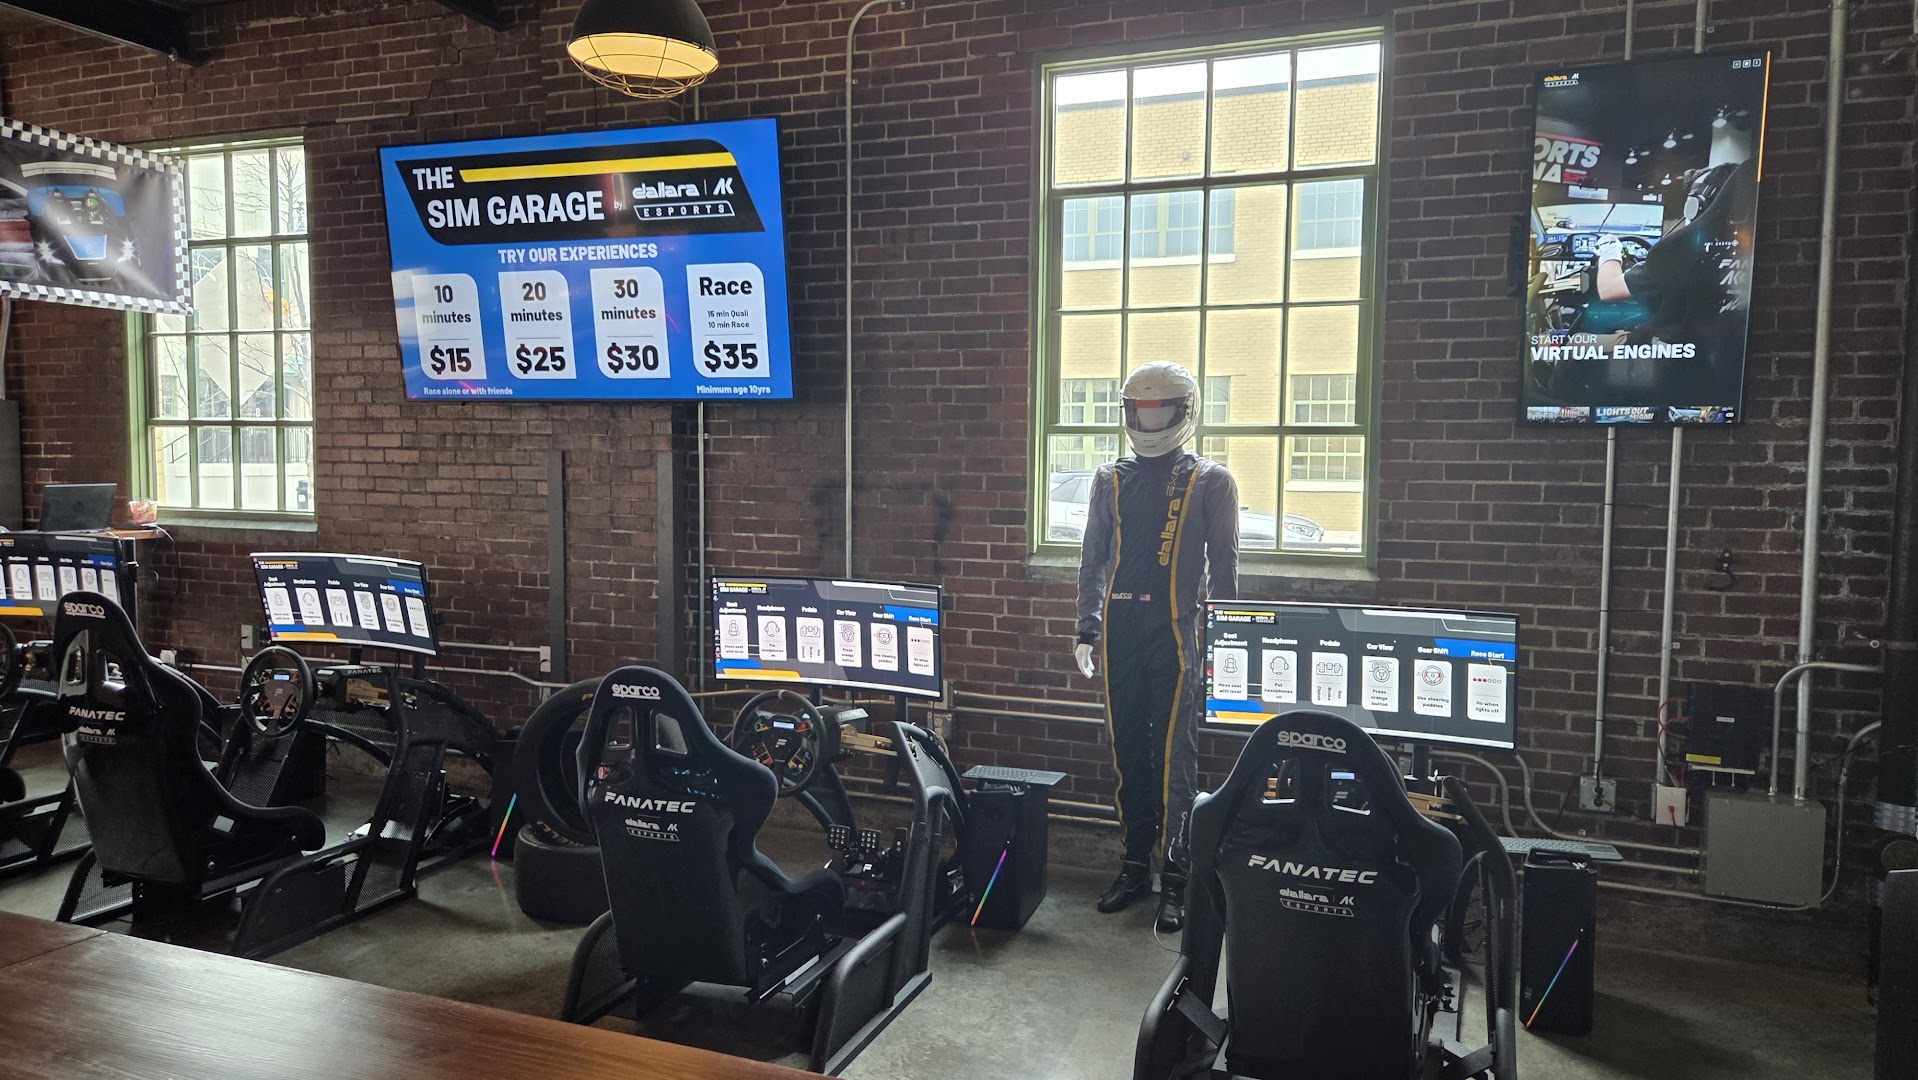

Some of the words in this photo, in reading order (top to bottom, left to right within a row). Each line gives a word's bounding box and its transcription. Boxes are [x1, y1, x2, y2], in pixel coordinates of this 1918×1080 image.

[413, 166, 454, 190] THE
[632, 181, 700, 199] dallara
[428, 198, 480, 228] SIM
[487, 190, 605, 225] GARAGE
[614, 201, 623, 211] by
[643, 204, 725, 217] ESPORTS
[498, 248, 525, 264] TRY
[529, 247, 557, 263] OUR
[560, 243, 658, 262] EXPERIENCES
[434, 285, 453, 303] 10
[522, 282, 546, 302] 20
[614, 279, 639, 299] 30
[699, 276, 753, 296] Race
[422, 310, 471, 324] minutes
[510, 308, 563, 322] minutes
[601, 306, 656, 320] minutes
[731, 310, 749, 318] Quali
[1531, 335, 1565, 345] START
[1567, 334, 1597, 344] YOUR
[430, 345, 472, 375] $15
[516, 343, 566, 374] $25
[607, 342, 659, 374] $30
[704, 340, 758, 372] $35
[1531, 346, 1609, 361] VIRTUAL
[1613, 343, 1696, 359] ENGINES
[423, 387, 441, 395] Race
[442, 387, 461, 395] alone
[471, 387, 486, 395] with
[487, 387, 513, 395] friends
[696, 385, 732, 394] Minimum
[733, 387, 748, 395] age
[749, 385, 771, 395] 10yrs
[1596, 406, 1630, 417] LIGHTS
[1631, 406, 1649, 415] OUT
[1157, 498, 1182, 567] dallara
[64, 602, 105, 617] sparco
[1214, 639, 1248, 647] Adjustment
[1262, 637, 1298, 646] Headphones
[612, 683, 661, 699] sparco
[69, 706, 126, 721] FANATEC
[1277, 730, 1347, 752] sparco
[604, 791, 696, 814] FANATEC
[1248, 854, 1378, 884] FANATEC
[1279, 888, 1329, 903] dallara
[1286, 901, 1347, 915] ESPORTS
